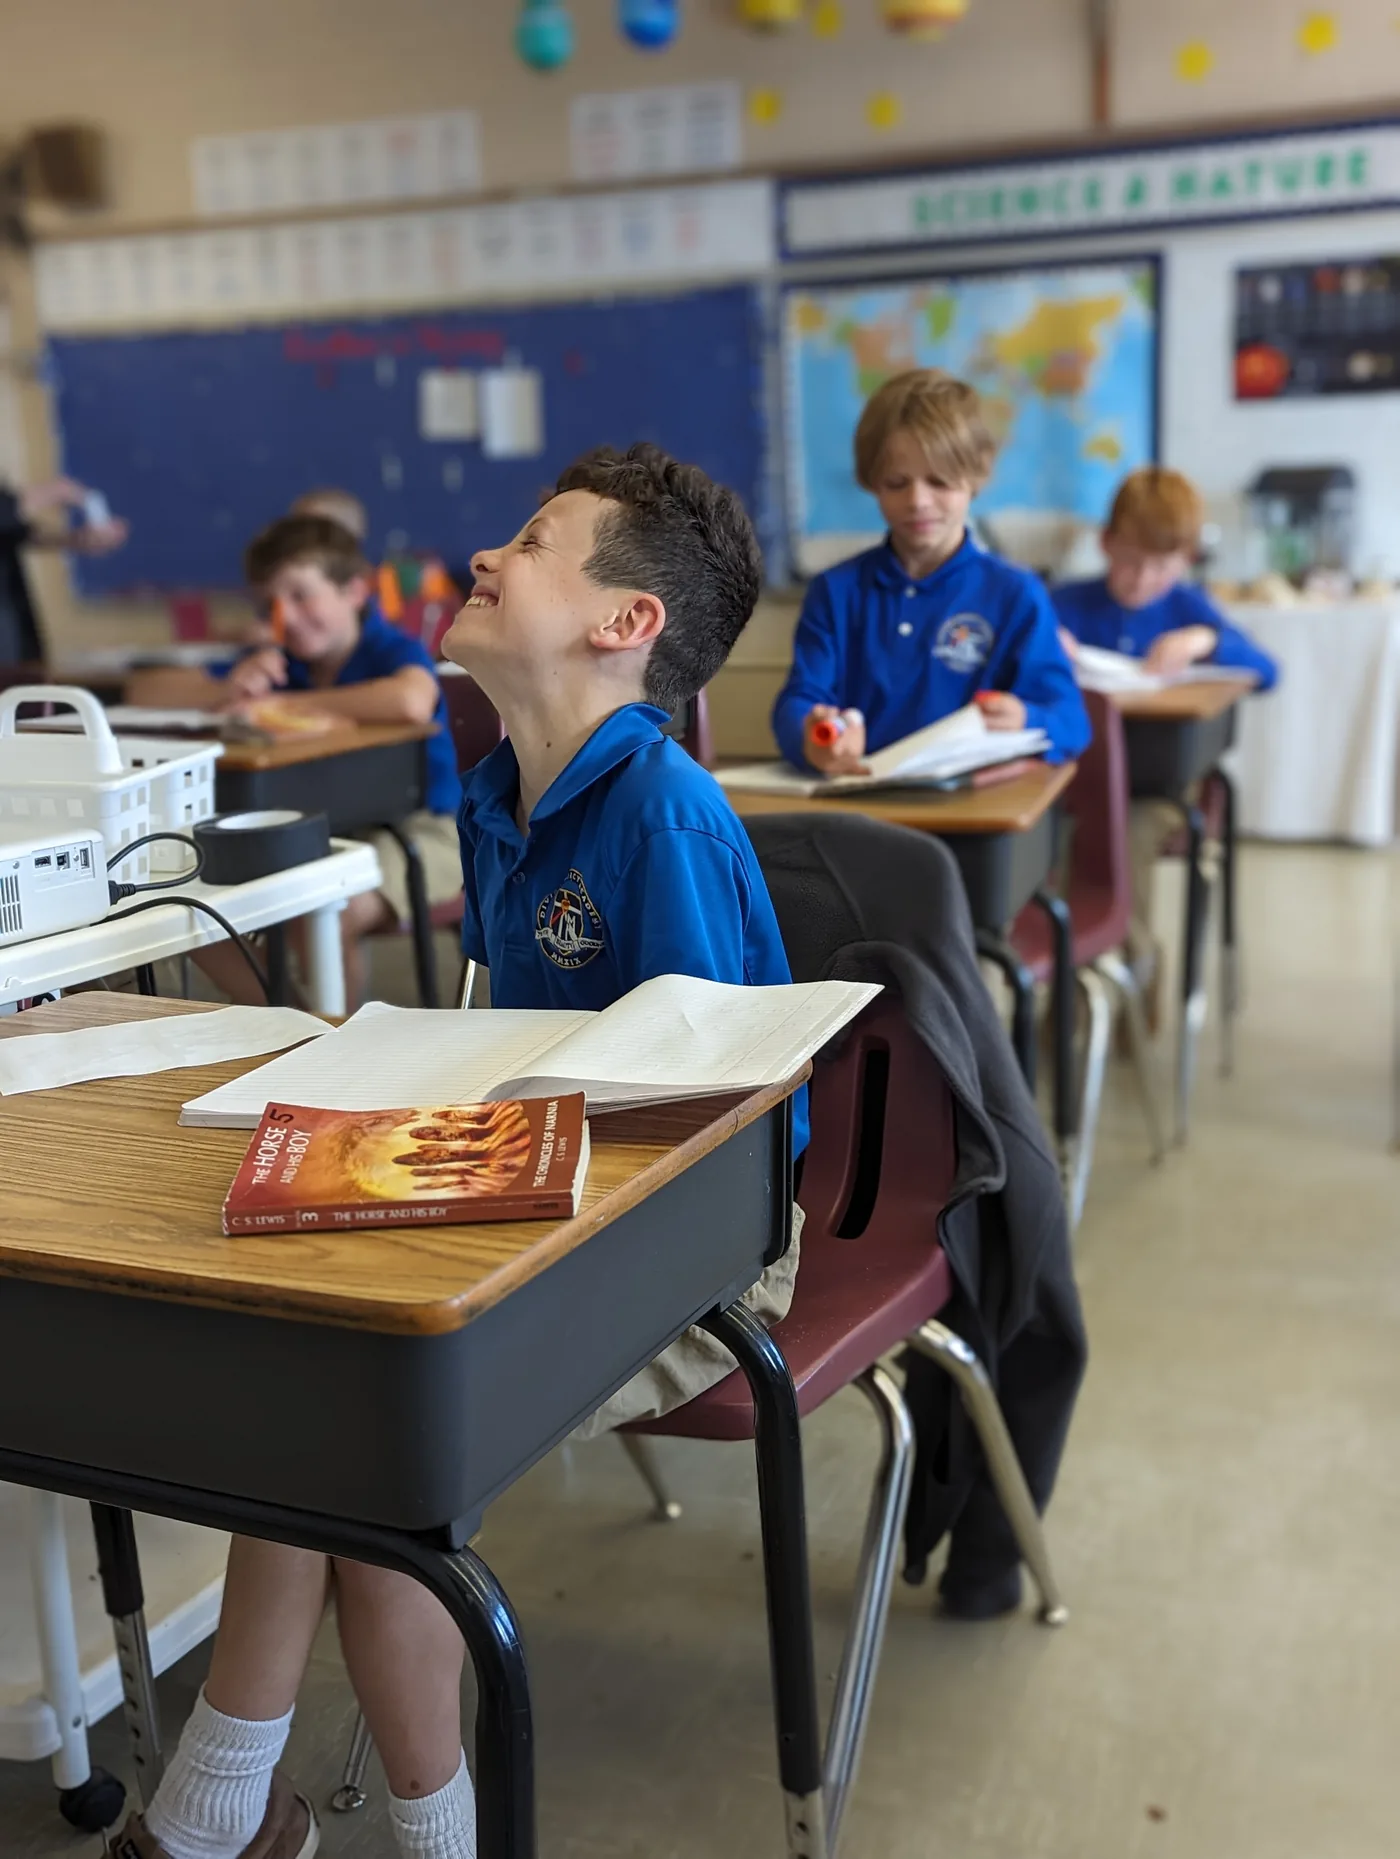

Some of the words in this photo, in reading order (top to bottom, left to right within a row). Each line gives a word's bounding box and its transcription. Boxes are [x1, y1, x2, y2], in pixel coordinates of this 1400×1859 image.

[913, 173, 1102, 233] SCIENCE
[1171, 148, 1369, 198] NATURE
[269, 1108, 295, 1124] 5
[545, 1100, 559, 1130] NARNIA
[286, 1129, 312, 1154] BOY
[543, 1131, 556, 1141] OF
[558, 1136, 568, 1152] LEWIS
[253, 1126, 288, 1168] HORSE
[286, 1154, 304, 1167] HIS
[536, 1142, 554, 1175] CHRONICLES
[252, 1168, 272, 1185] THE
[280, 1166, 298, 1184] AND
[533, 1176, 547, 1188] THE
[256, 1214, 286, 1225] LEWIS
[302, 1212, 319, 1222] 3
[334, 1211, 352, 1221] THE
[355, 1209, 387, 1220] HORSE
[388, 1208, 410, 1219] AND
[411, 1207, 428, 1218] HIS
[429, 1206, 448, 1217] BOY
